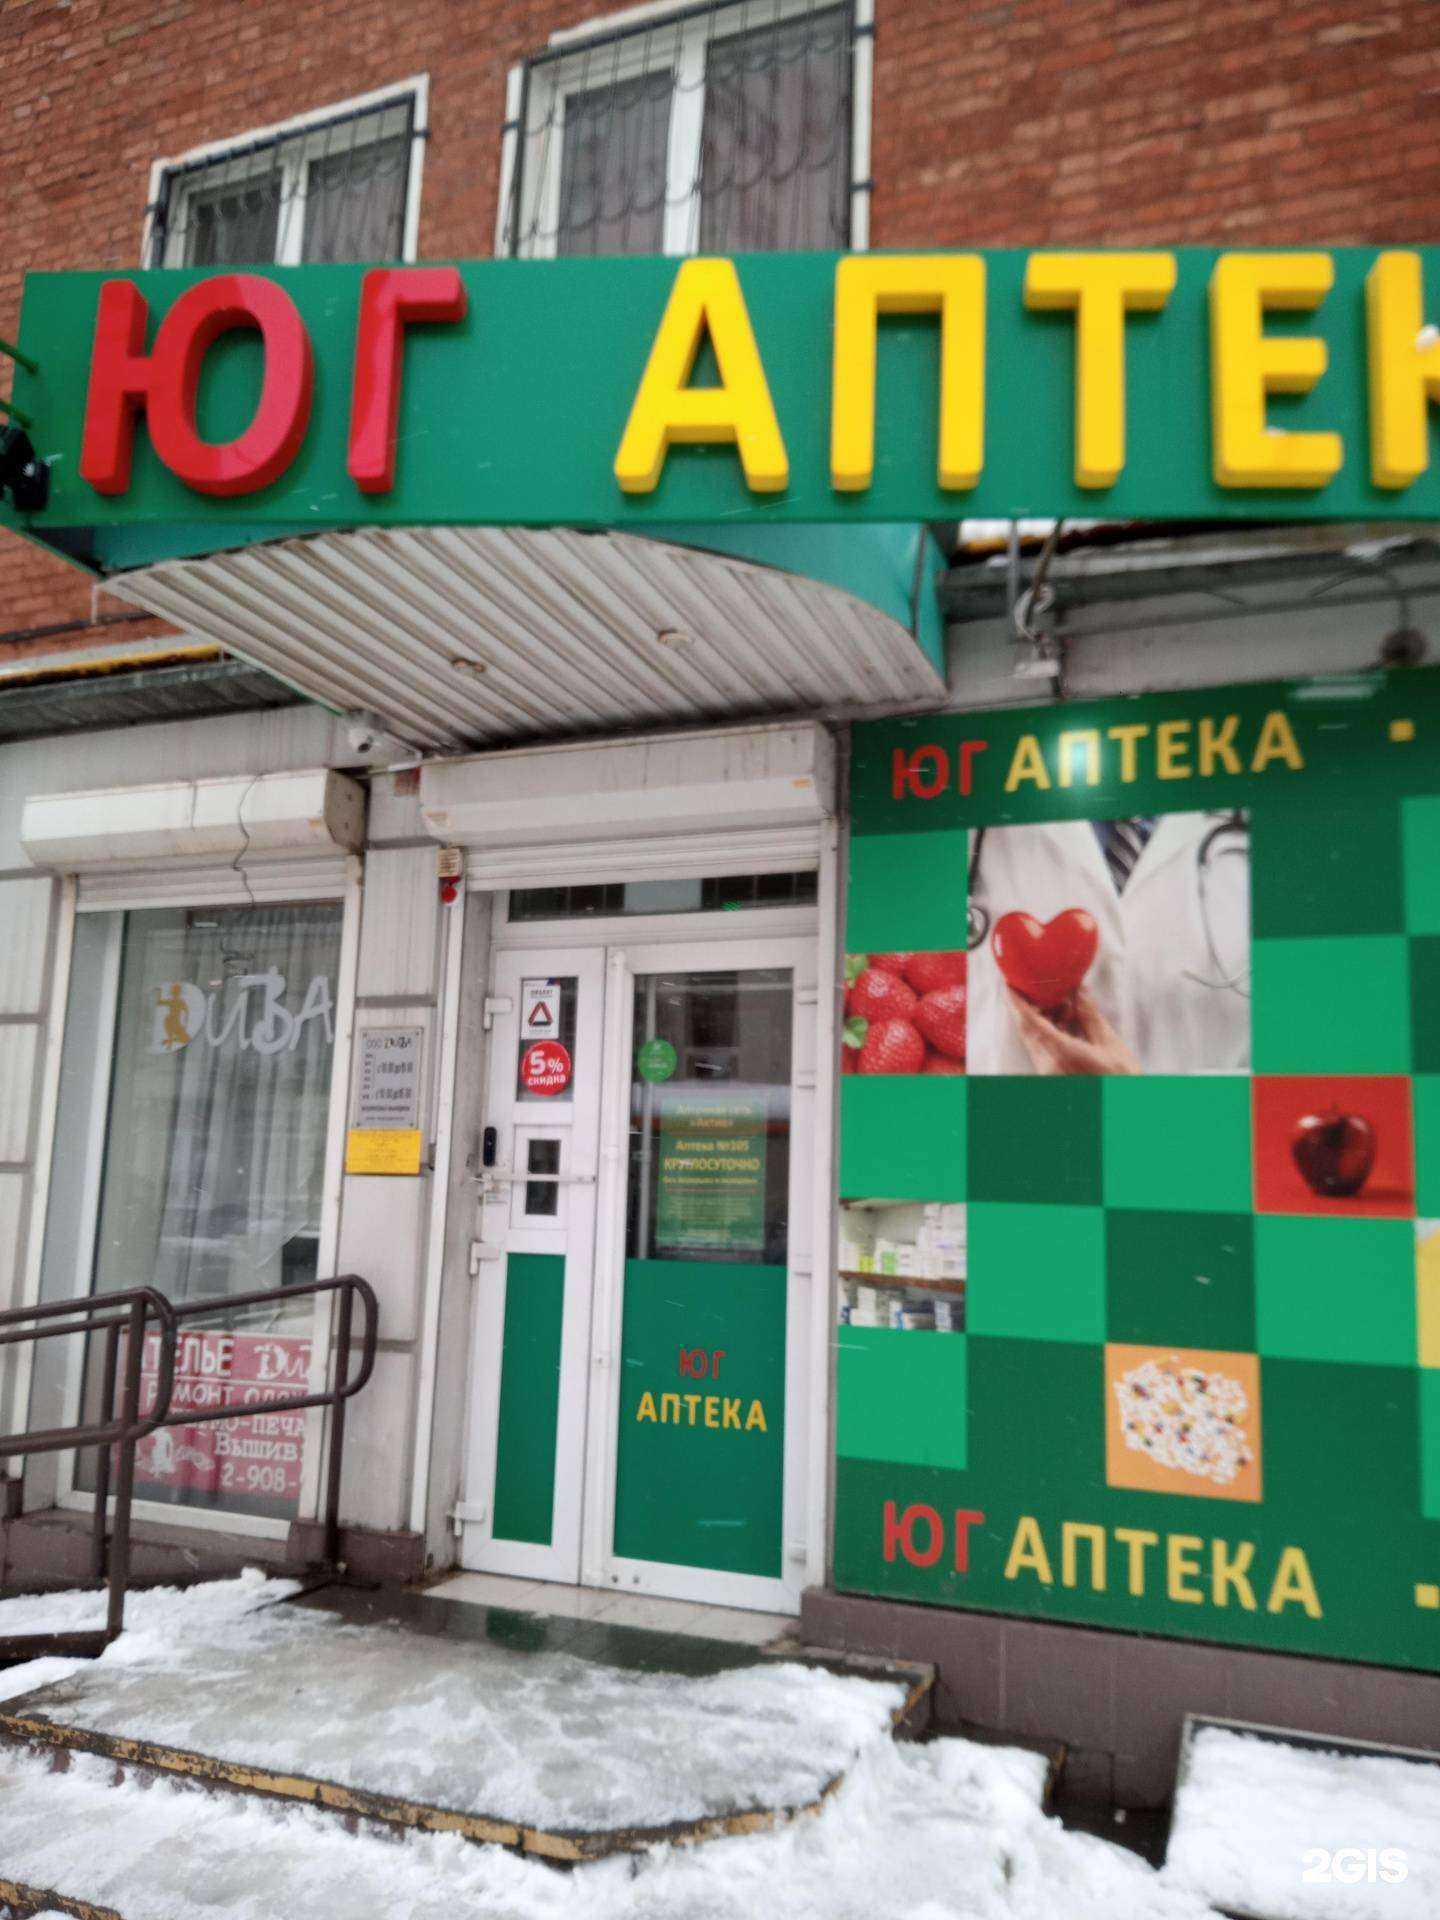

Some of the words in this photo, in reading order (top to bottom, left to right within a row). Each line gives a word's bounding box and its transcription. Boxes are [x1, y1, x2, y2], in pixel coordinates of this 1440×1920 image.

[80, 266, 468, 496] ЮГ
[891, 740, 988, 801] ЮГ
[1004, 709, 1305, 793] АПТЕКА
[529, 1049, 564, 1076] 5%
[679, 1347, 727, 1380] ЮГ
[636, 1391, 768, 1433] АПТЕКА
[883, 1500, 985, 1574] ЮГ
[1003, 1515, 1323, 1620] АПТЕКА
